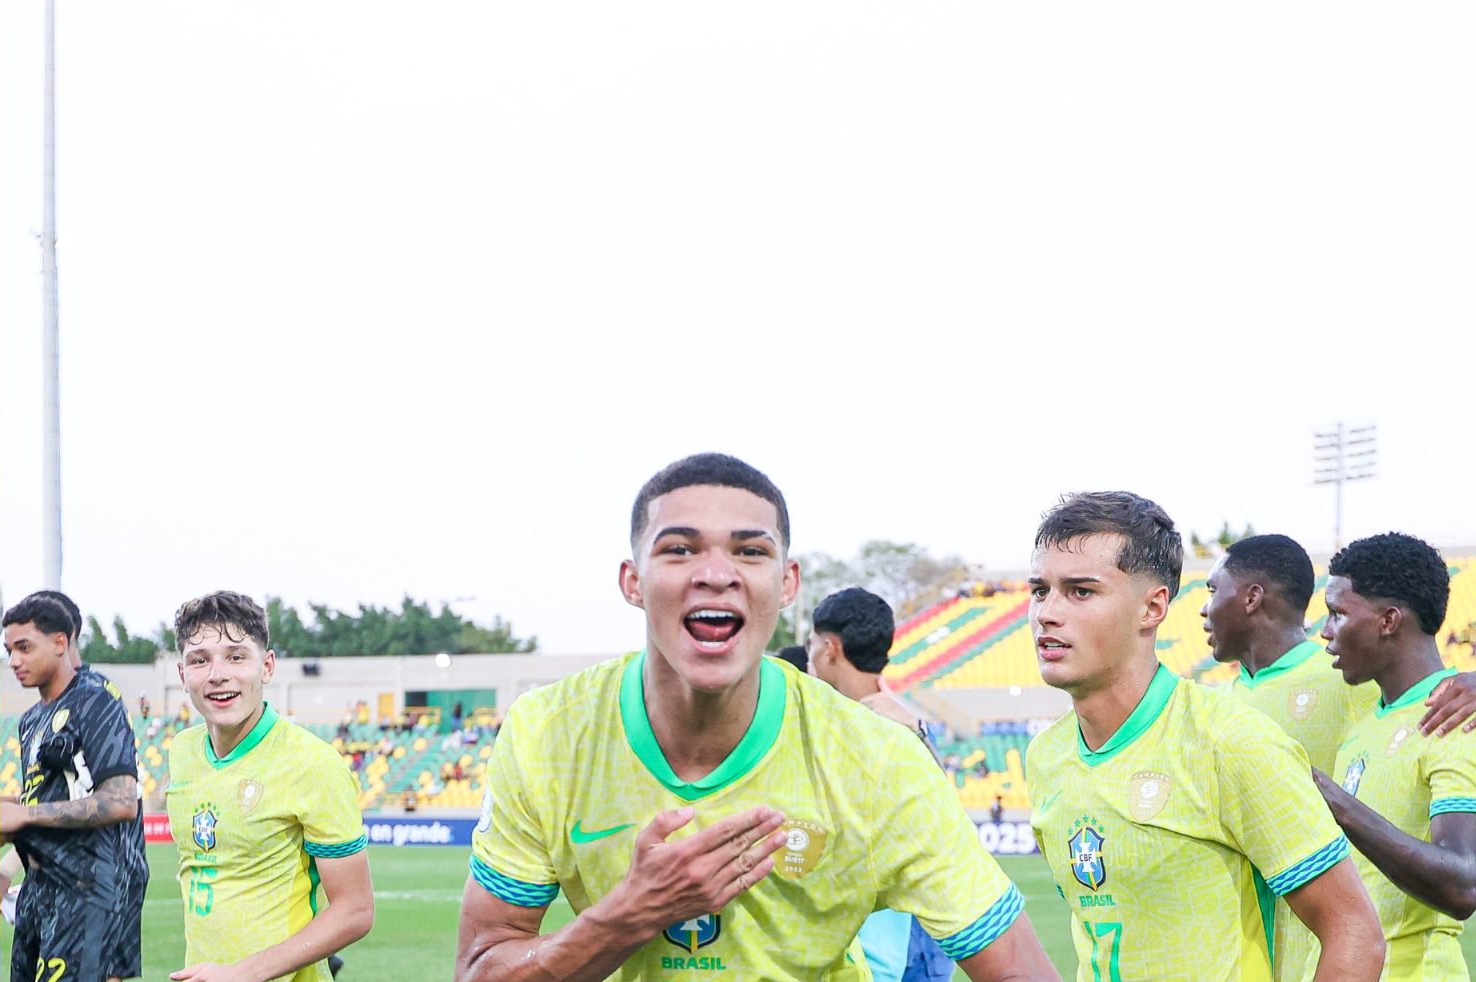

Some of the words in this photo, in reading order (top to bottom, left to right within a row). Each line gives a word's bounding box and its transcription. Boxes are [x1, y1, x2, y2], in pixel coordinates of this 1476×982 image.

[979, 821, 1038, 855] 025
[1079, 853, 1093, 863] CBF
[189, 865, 218, 917] 15
[1079, 894, 1116, 908] BRASIL
[661, 956, 727, 971] BRASIL
